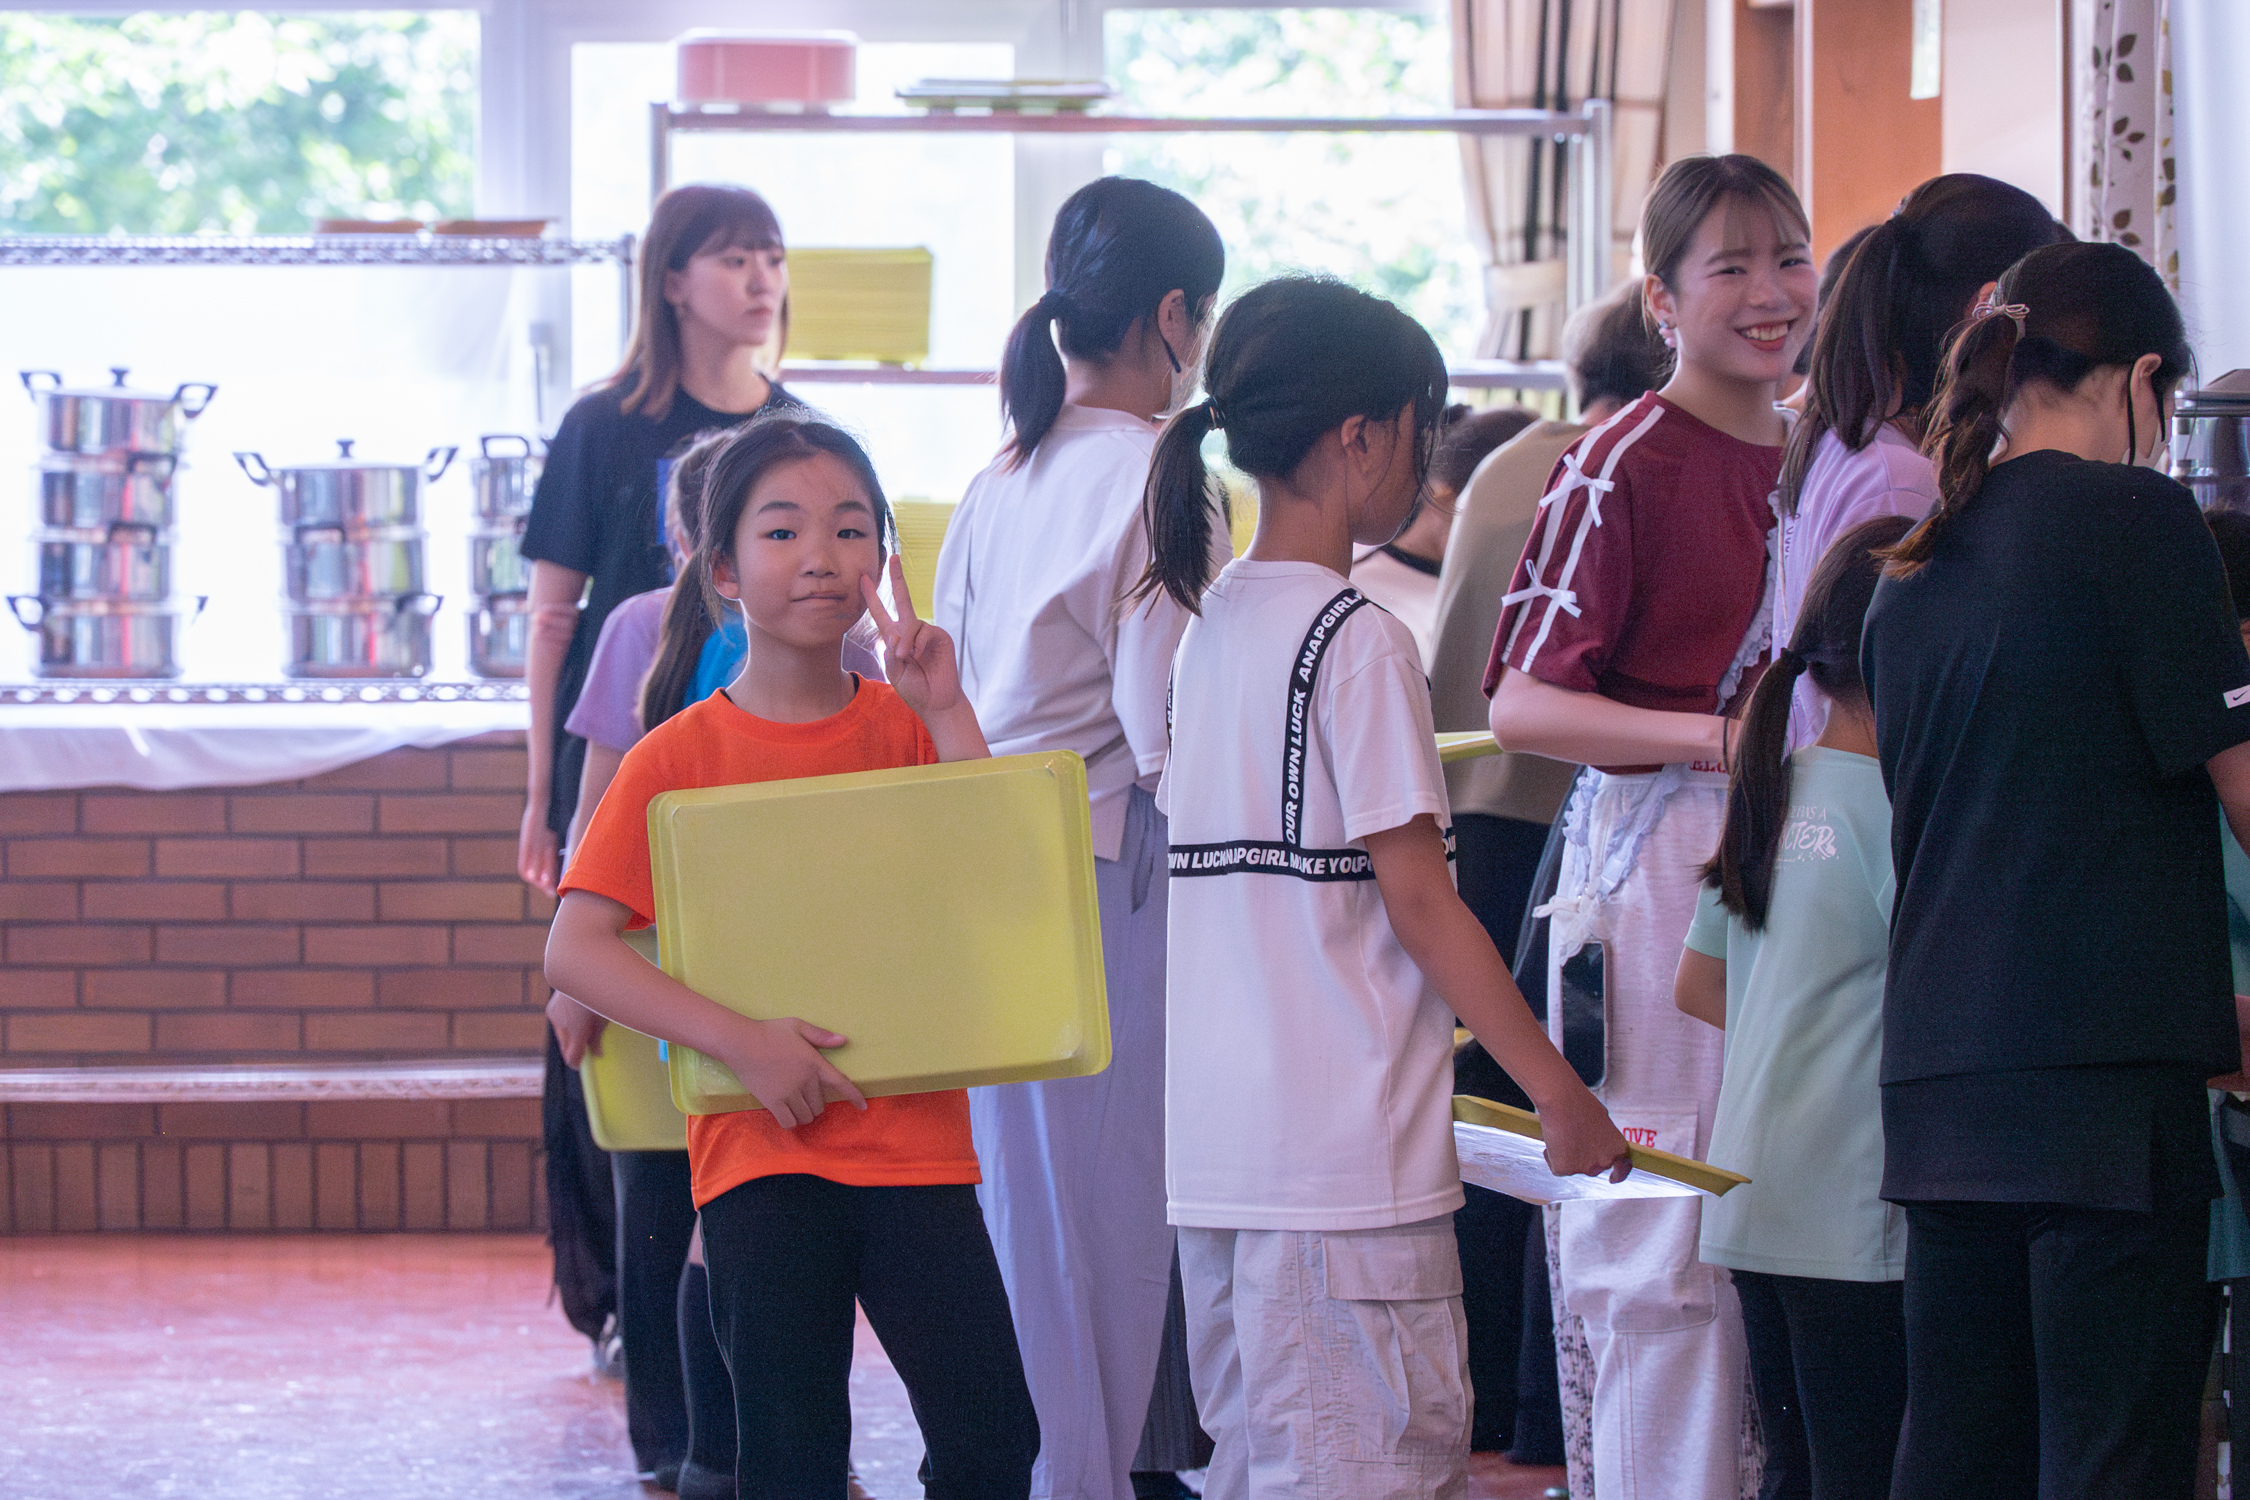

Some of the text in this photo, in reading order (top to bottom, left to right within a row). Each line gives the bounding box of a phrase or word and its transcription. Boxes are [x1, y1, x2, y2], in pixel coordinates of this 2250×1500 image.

[1298, 595, 1359, 684] ANAPGIRL
[1290, 688, 1307, 747] LUCK
[1288, 747, 1301, 800] OWN
[1285, 801, 1298, 845] OUR
[1168, 852, 1190, 870] WN
[1622, 1126, 1657, 1148] OVE
